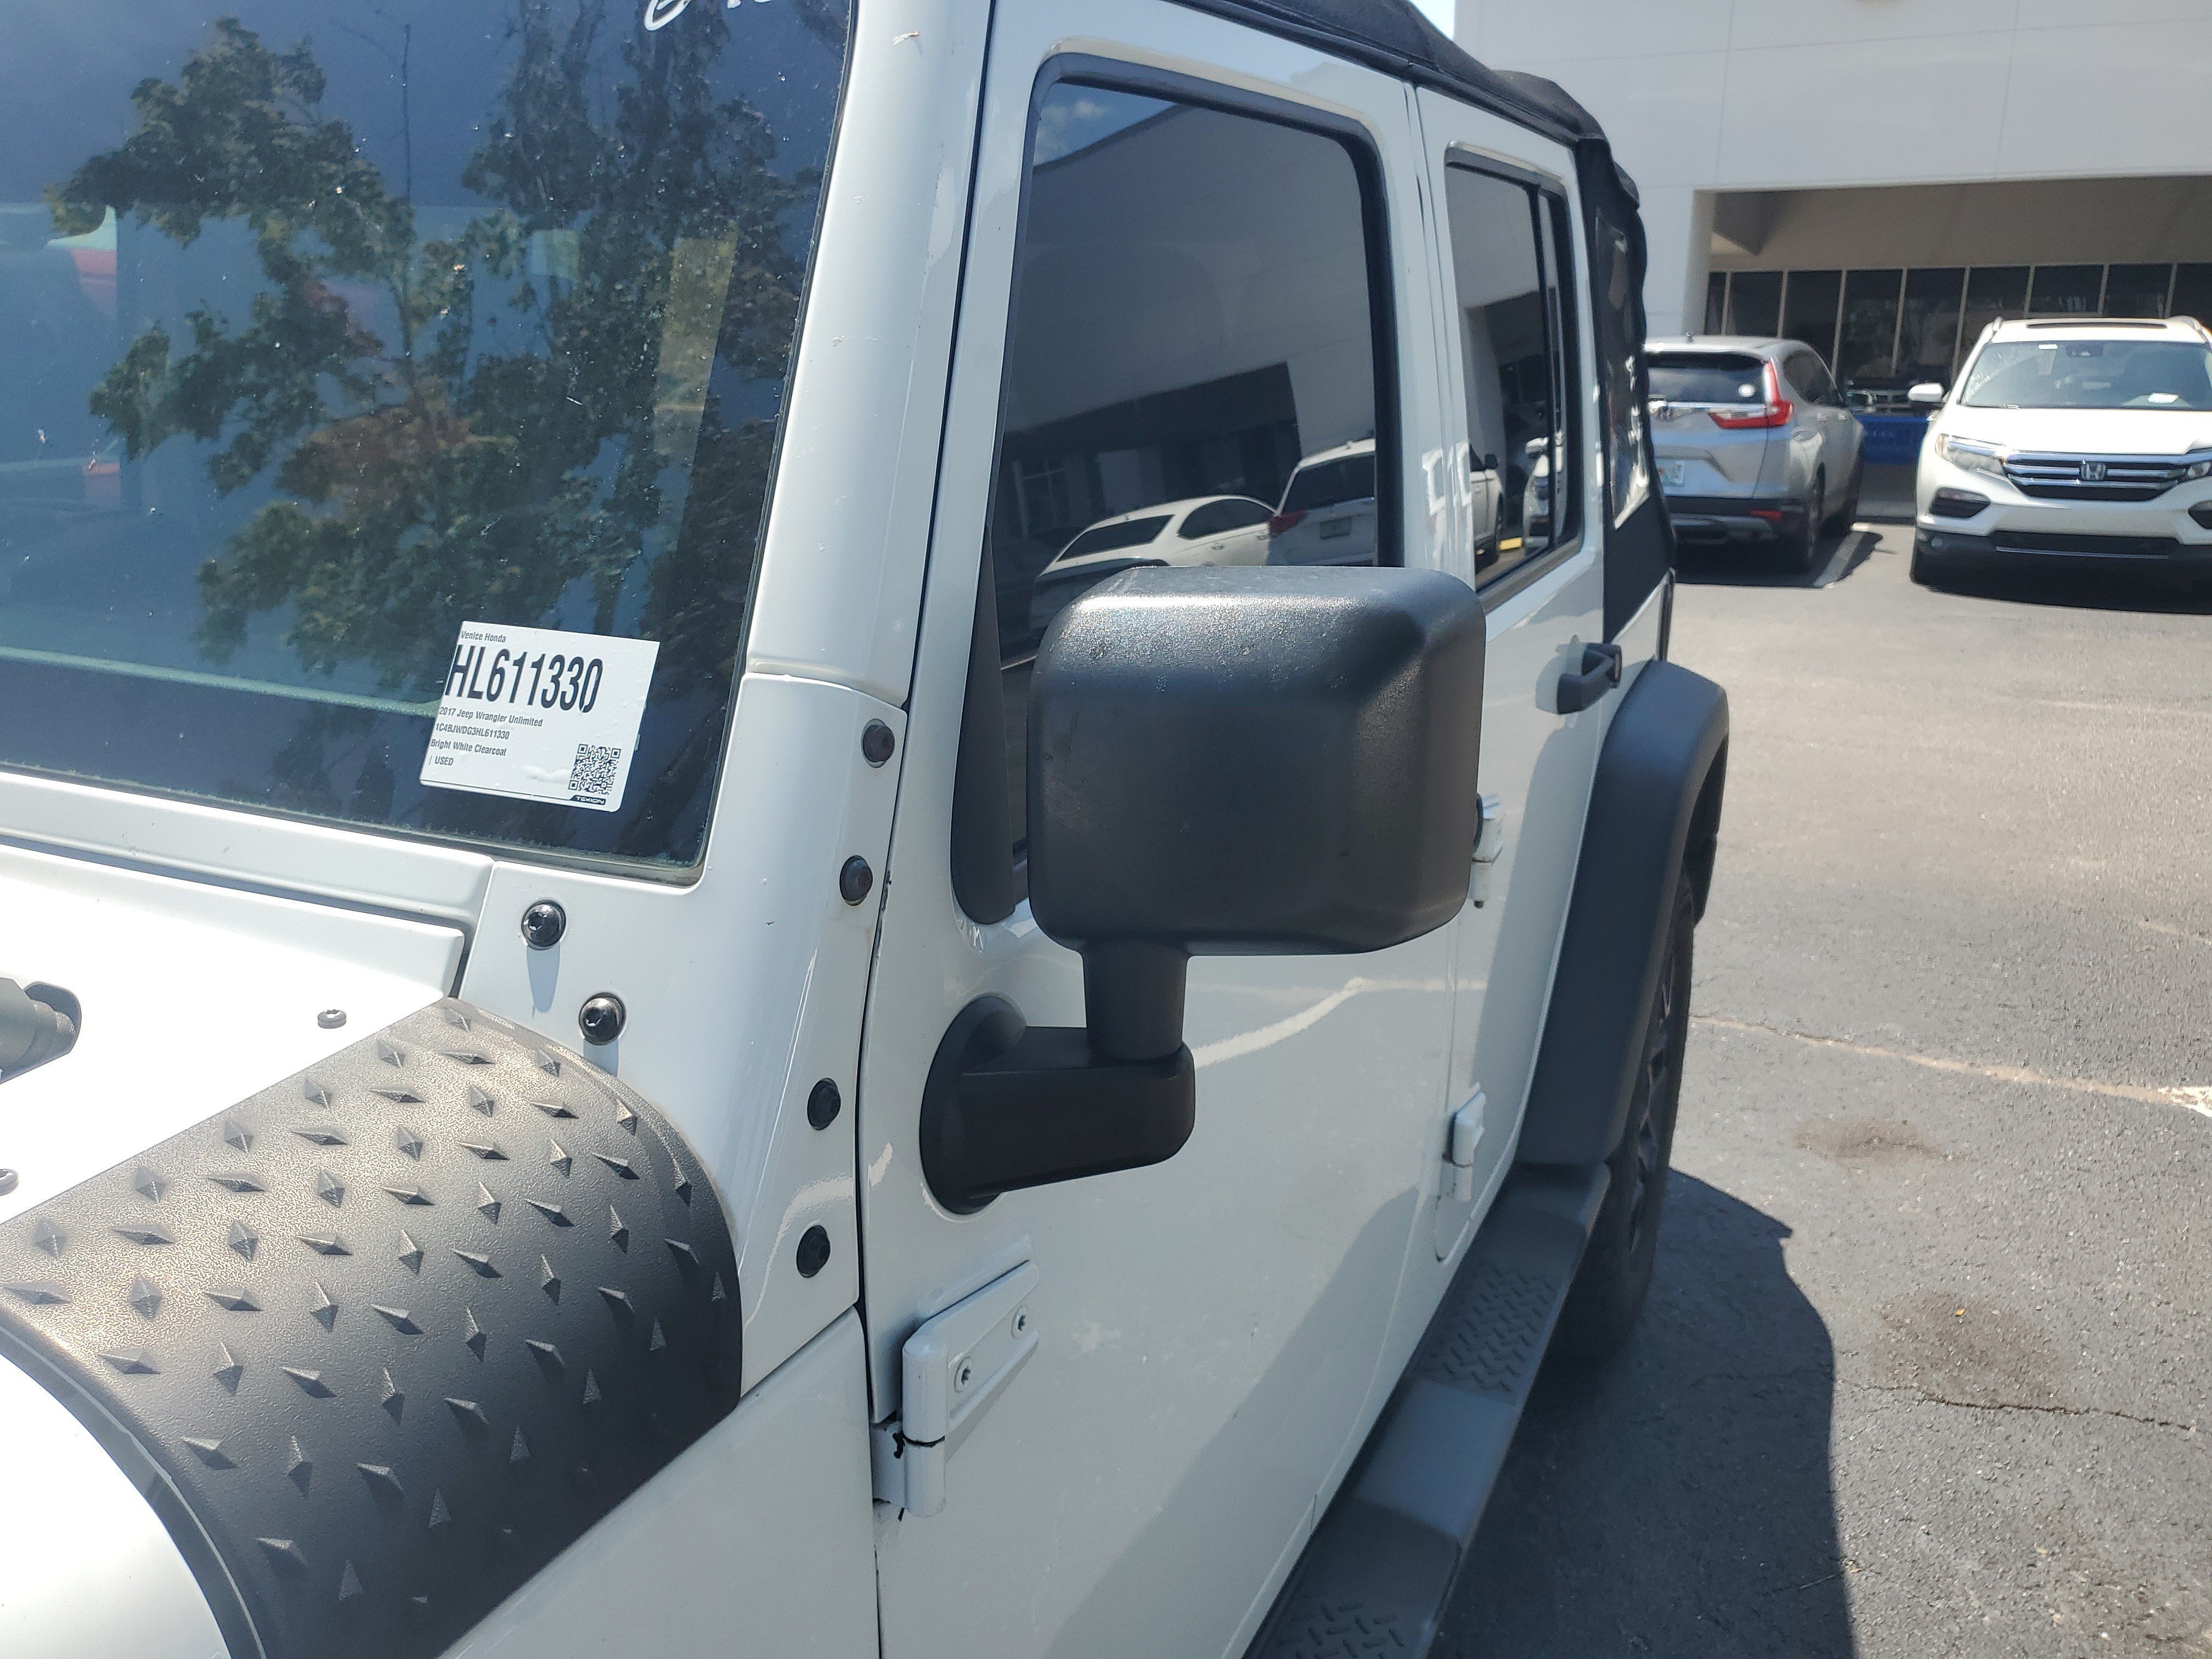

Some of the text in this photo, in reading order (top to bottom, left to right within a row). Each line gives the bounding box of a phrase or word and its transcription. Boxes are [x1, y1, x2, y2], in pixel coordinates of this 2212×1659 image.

[461, 630, 507, 643] Venice Honda
[445, 644, 603, 713] HL611330
[439, 706, 544, 727] 2017 Jeep Wrangler Unlimited
[436, 723, 510, 740] 1C4BJWDG3HL611330
[431, 738, 507, 757] Bright White Clearcoat
[435, 755, 454, 766] USED
[575, 795, 605, 804] TEKION
